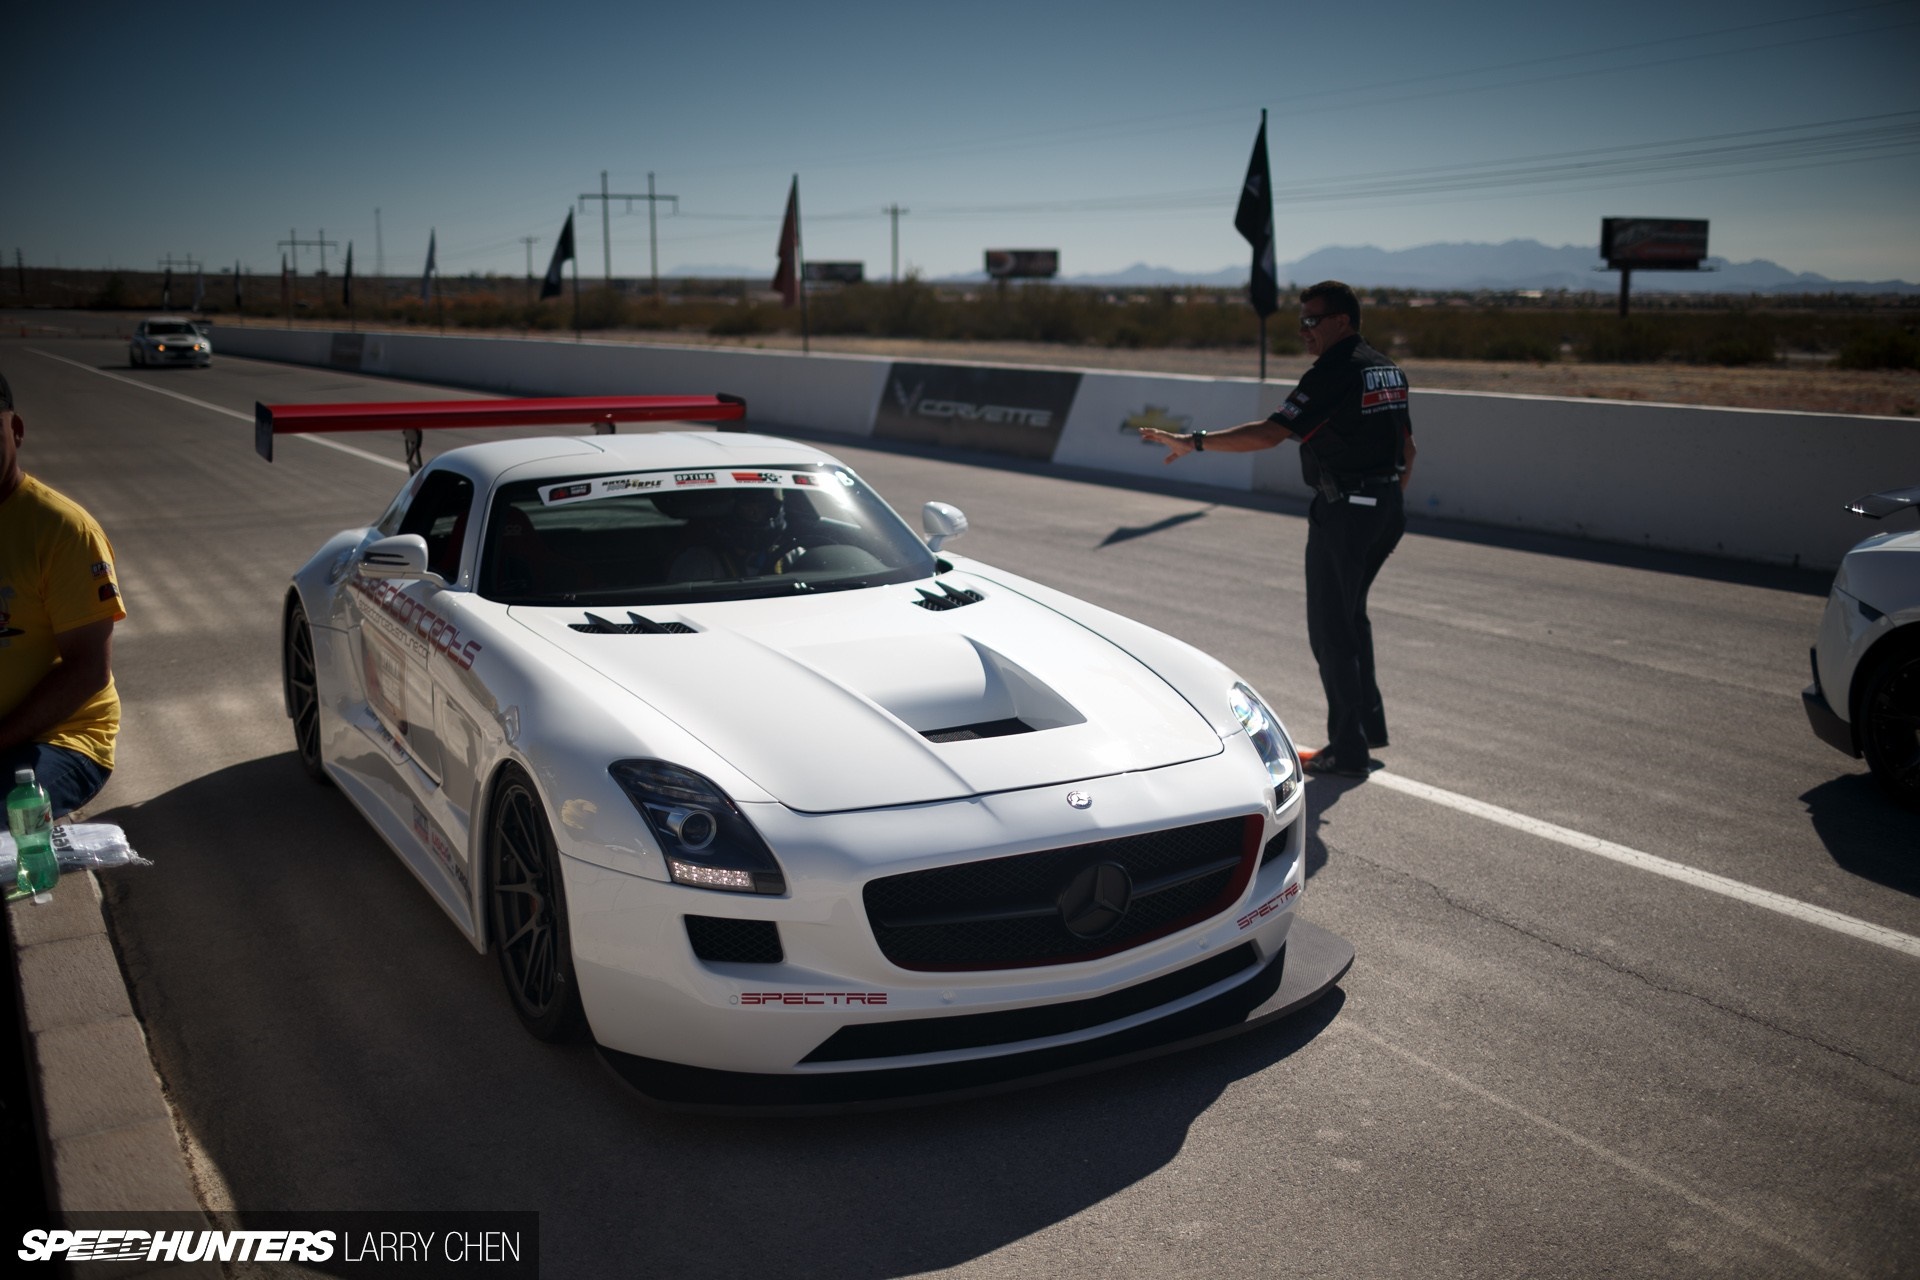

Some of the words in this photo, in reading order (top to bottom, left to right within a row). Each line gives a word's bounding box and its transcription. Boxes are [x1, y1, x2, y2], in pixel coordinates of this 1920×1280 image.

[1366, 370, 1404, 390] OPTIMA
[917, 399, 1052, 427] CORVETTE
[676, 473, 715, 481] OPTIMA
[1236, 882, 1299, 930] SPECTRE
[741, 993, 887, 1005] SPECTRE
